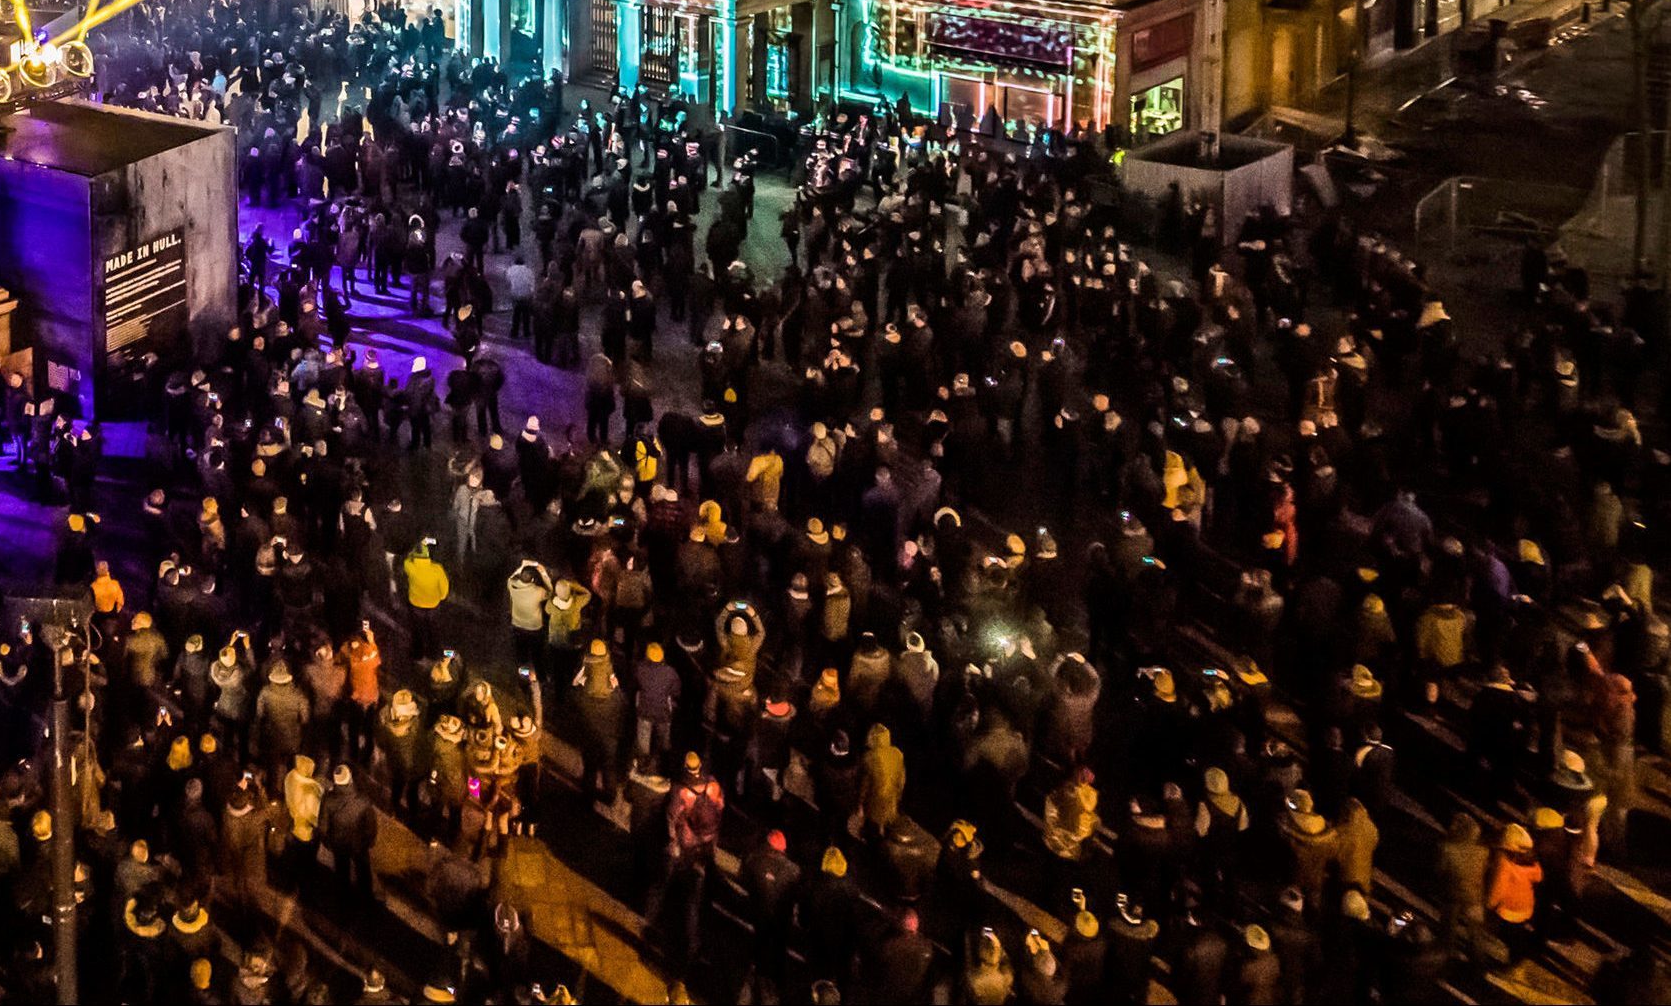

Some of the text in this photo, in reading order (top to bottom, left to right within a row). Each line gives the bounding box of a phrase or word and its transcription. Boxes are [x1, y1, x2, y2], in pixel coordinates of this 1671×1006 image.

[105, 234, 182, 273] MADE IN HULL.
